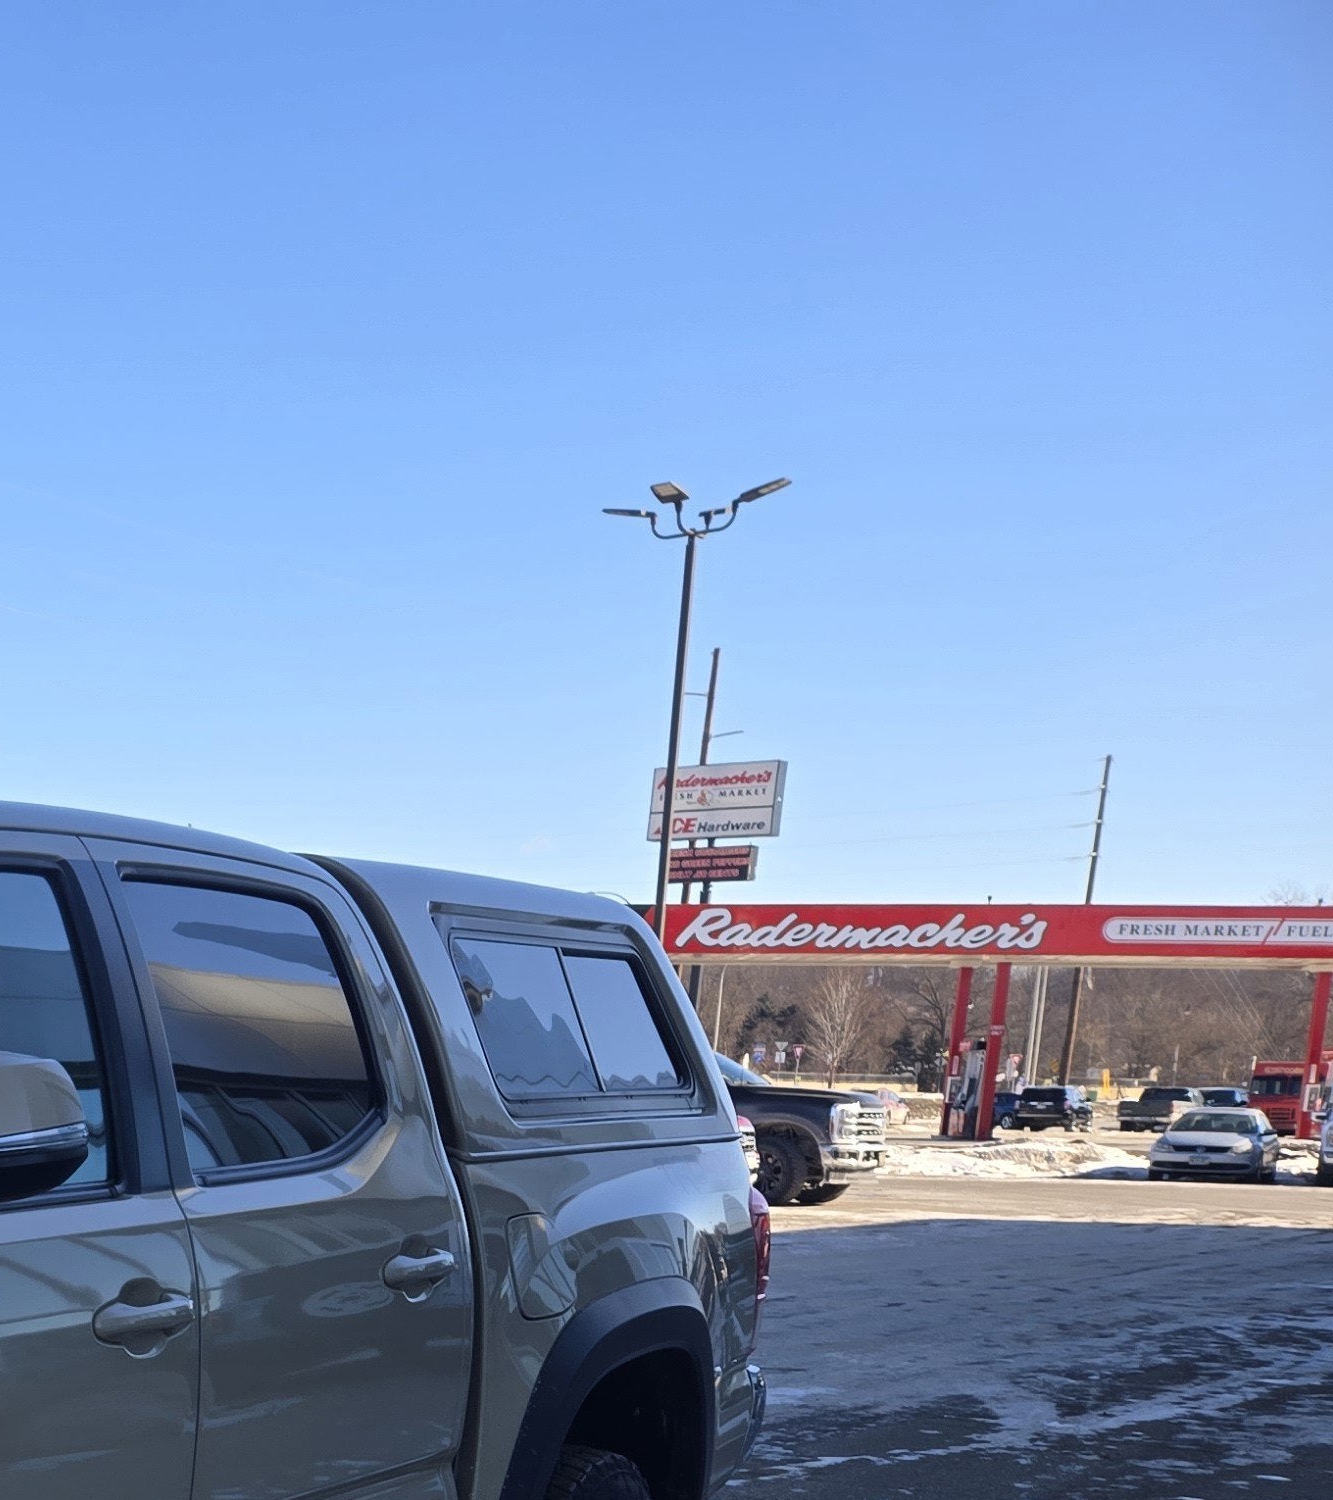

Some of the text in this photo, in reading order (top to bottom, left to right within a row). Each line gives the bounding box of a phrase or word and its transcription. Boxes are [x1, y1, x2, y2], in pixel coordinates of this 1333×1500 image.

[657, 769, 773, 790] dermacher's
[718, 788, 767, 798] MARKET
[697, 820, 766, 834] Hardware
[675, 907, 1048, 950] Radermacher's
[1118, 923, 1333, 938] FRESH MARKET FUEL
